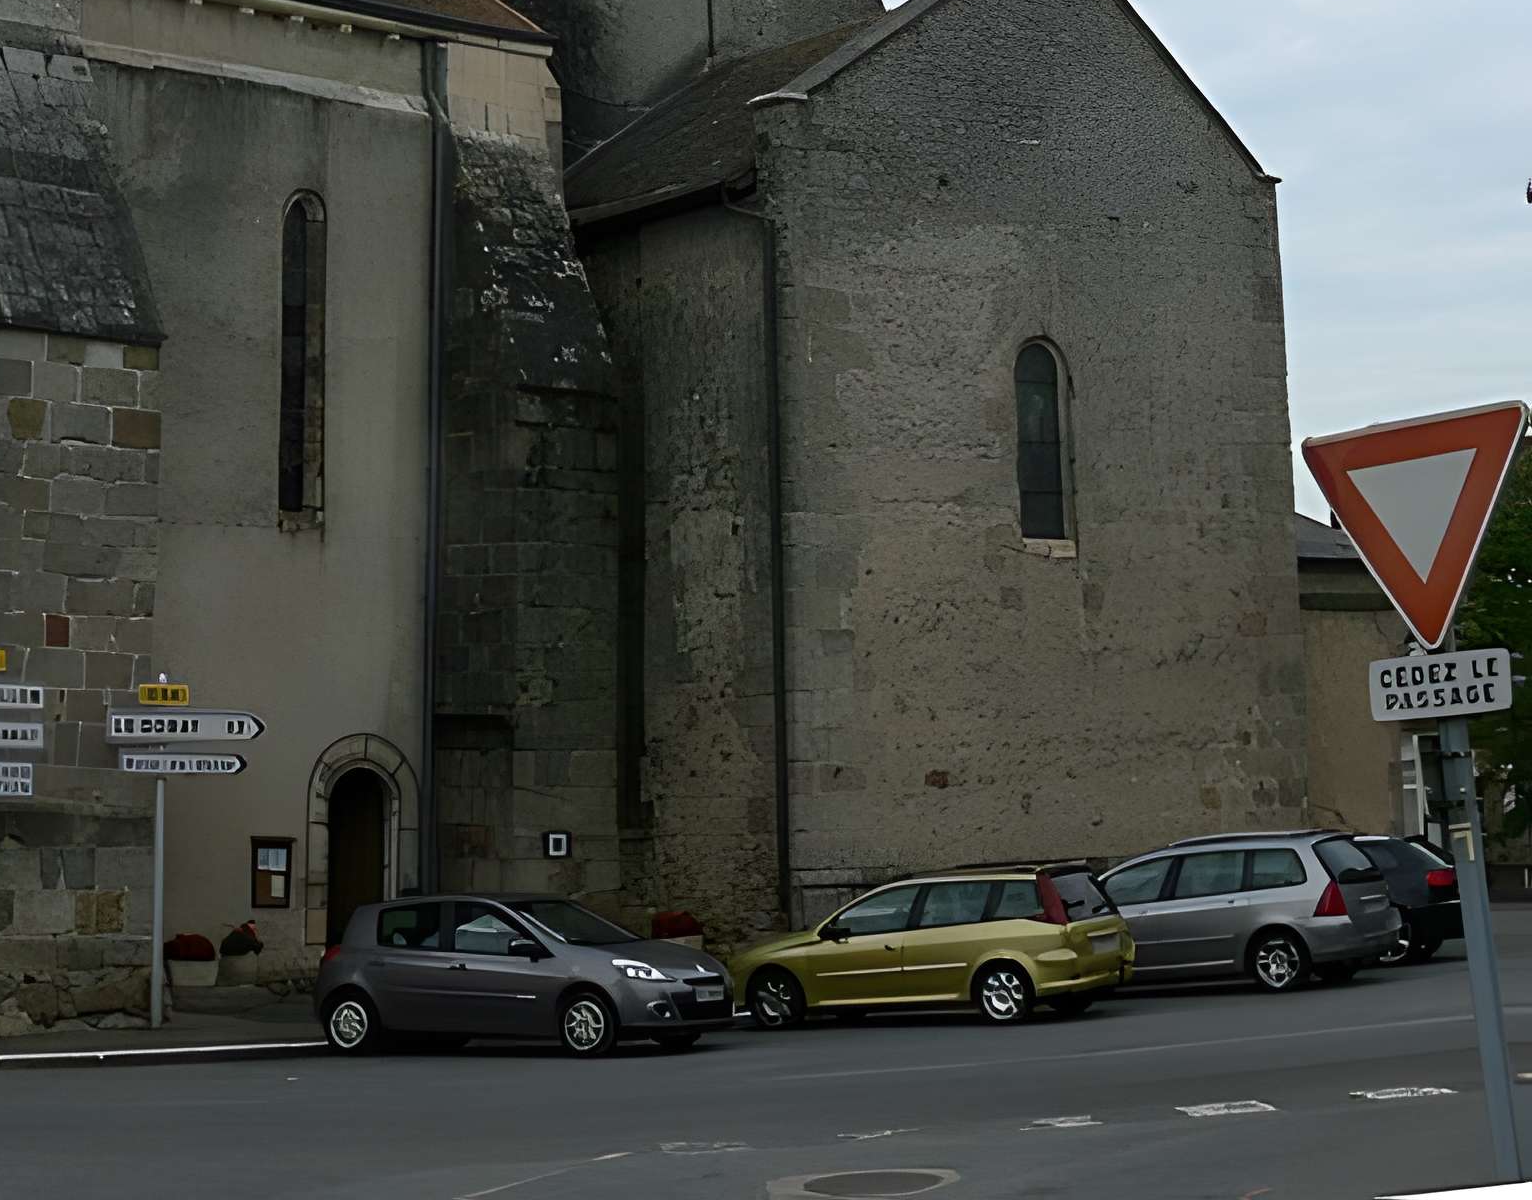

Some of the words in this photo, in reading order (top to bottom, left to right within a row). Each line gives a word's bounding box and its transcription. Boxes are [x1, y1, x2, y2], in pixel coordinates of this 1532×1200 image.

[1380, 662, 1457, 689] CEDEZ
[1471, 657, 1499, 679] LE
[1385, 682, 1496, 711] PASSAGE
